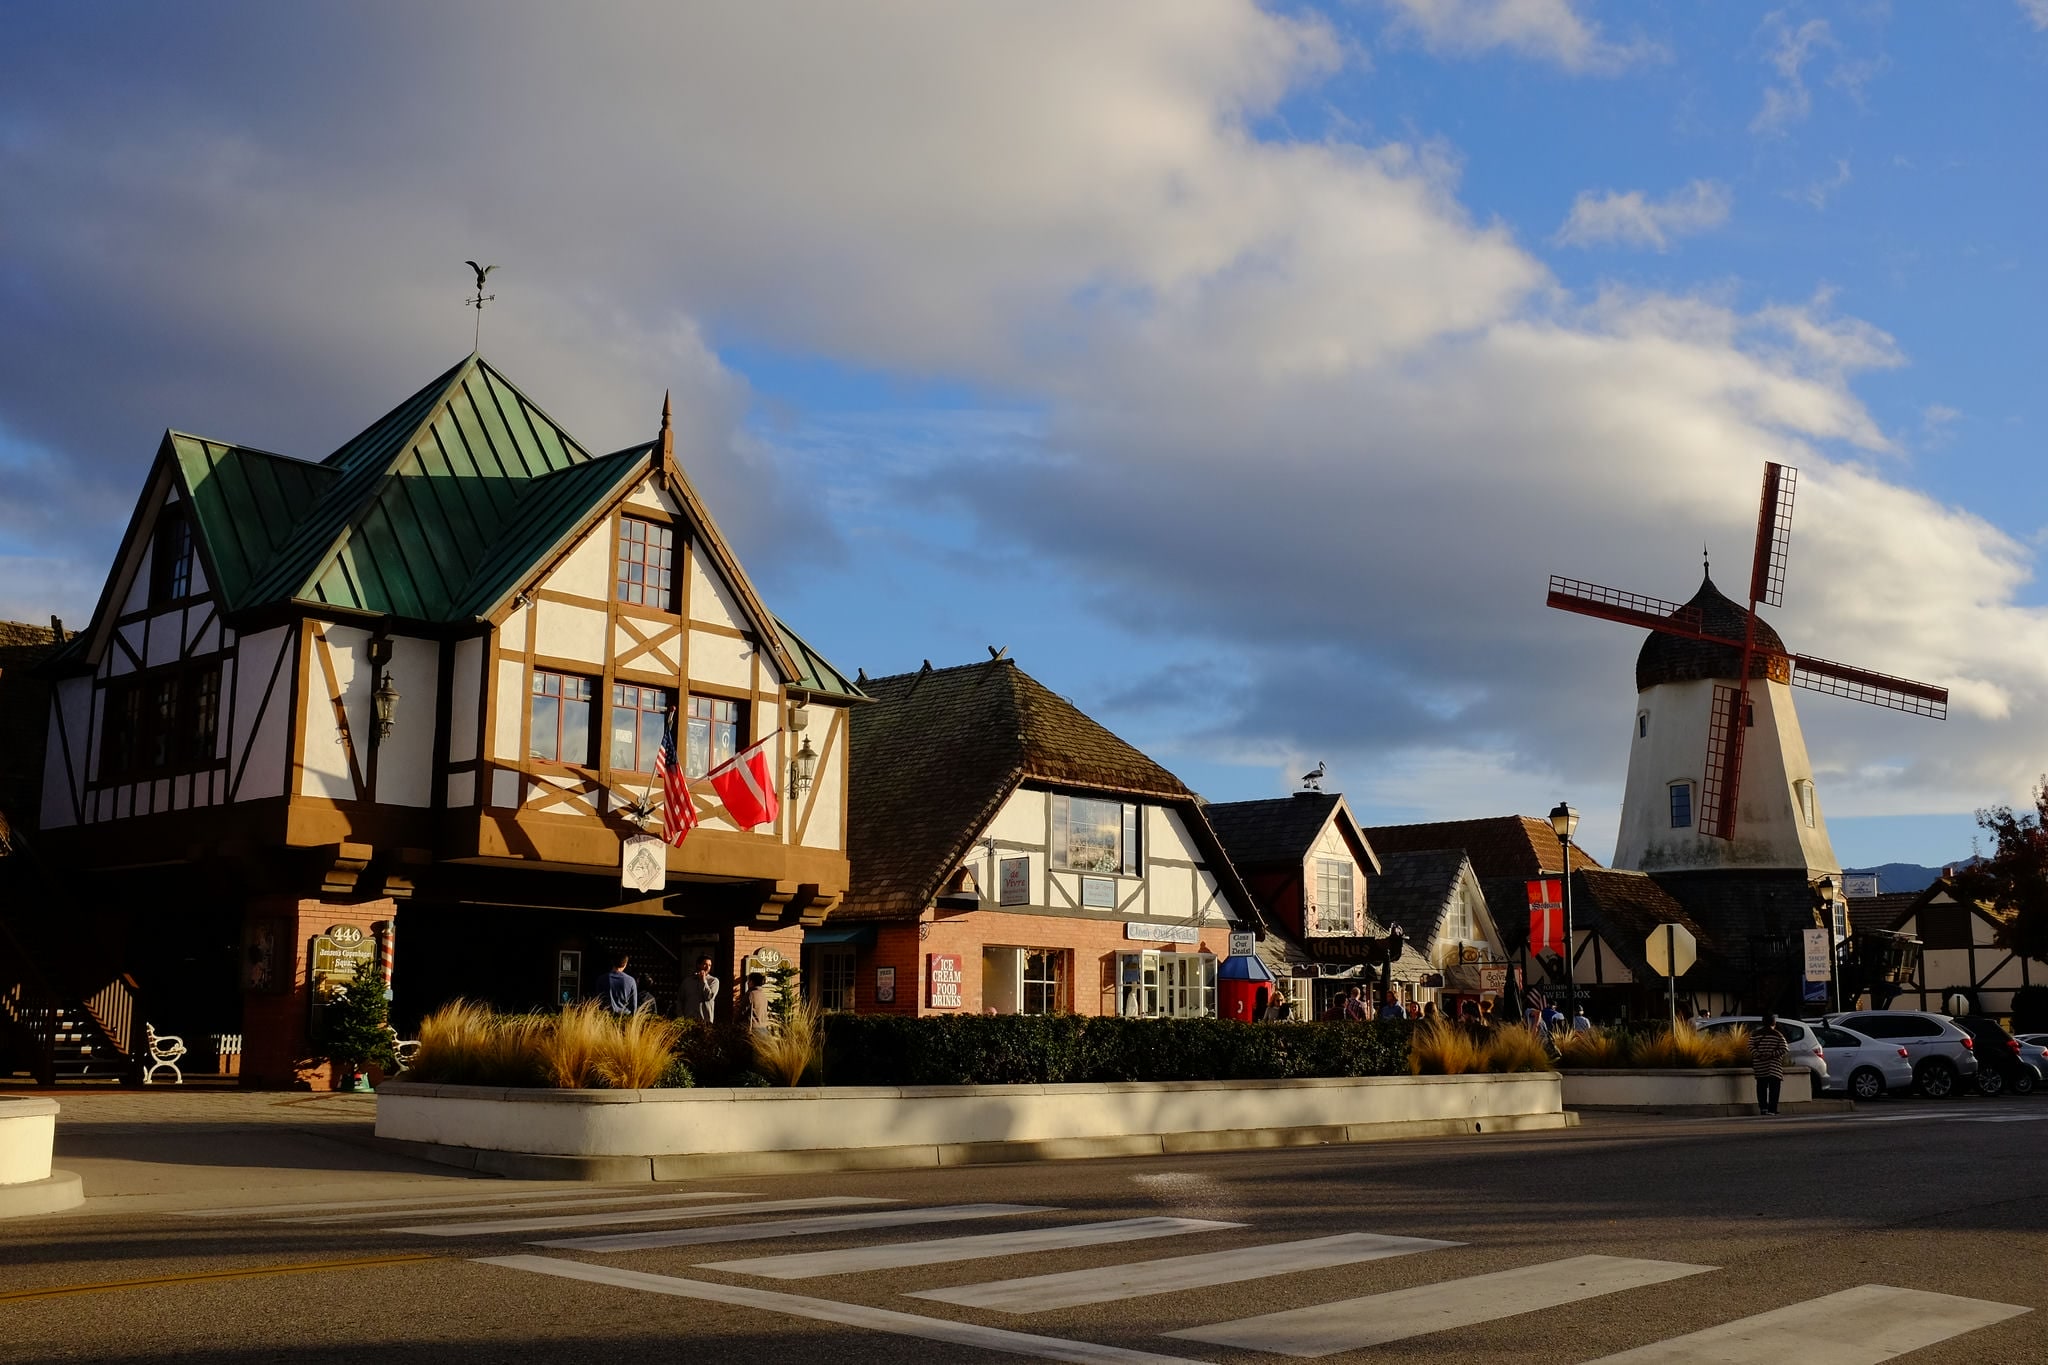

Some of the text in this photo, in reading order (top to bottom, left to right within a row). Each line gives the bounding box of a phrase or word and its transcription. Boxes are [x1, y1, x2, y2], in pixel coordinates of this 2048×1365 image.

[334, 928, 361, 941] 446
[761, 950, 779, 963] 446
[940, 959, 954, 971] ICE
[932, 970, 962, 982] CREAM
[936, 983, 957, 995] FOOD
[932, 994, 962, 1007] DRINKS
